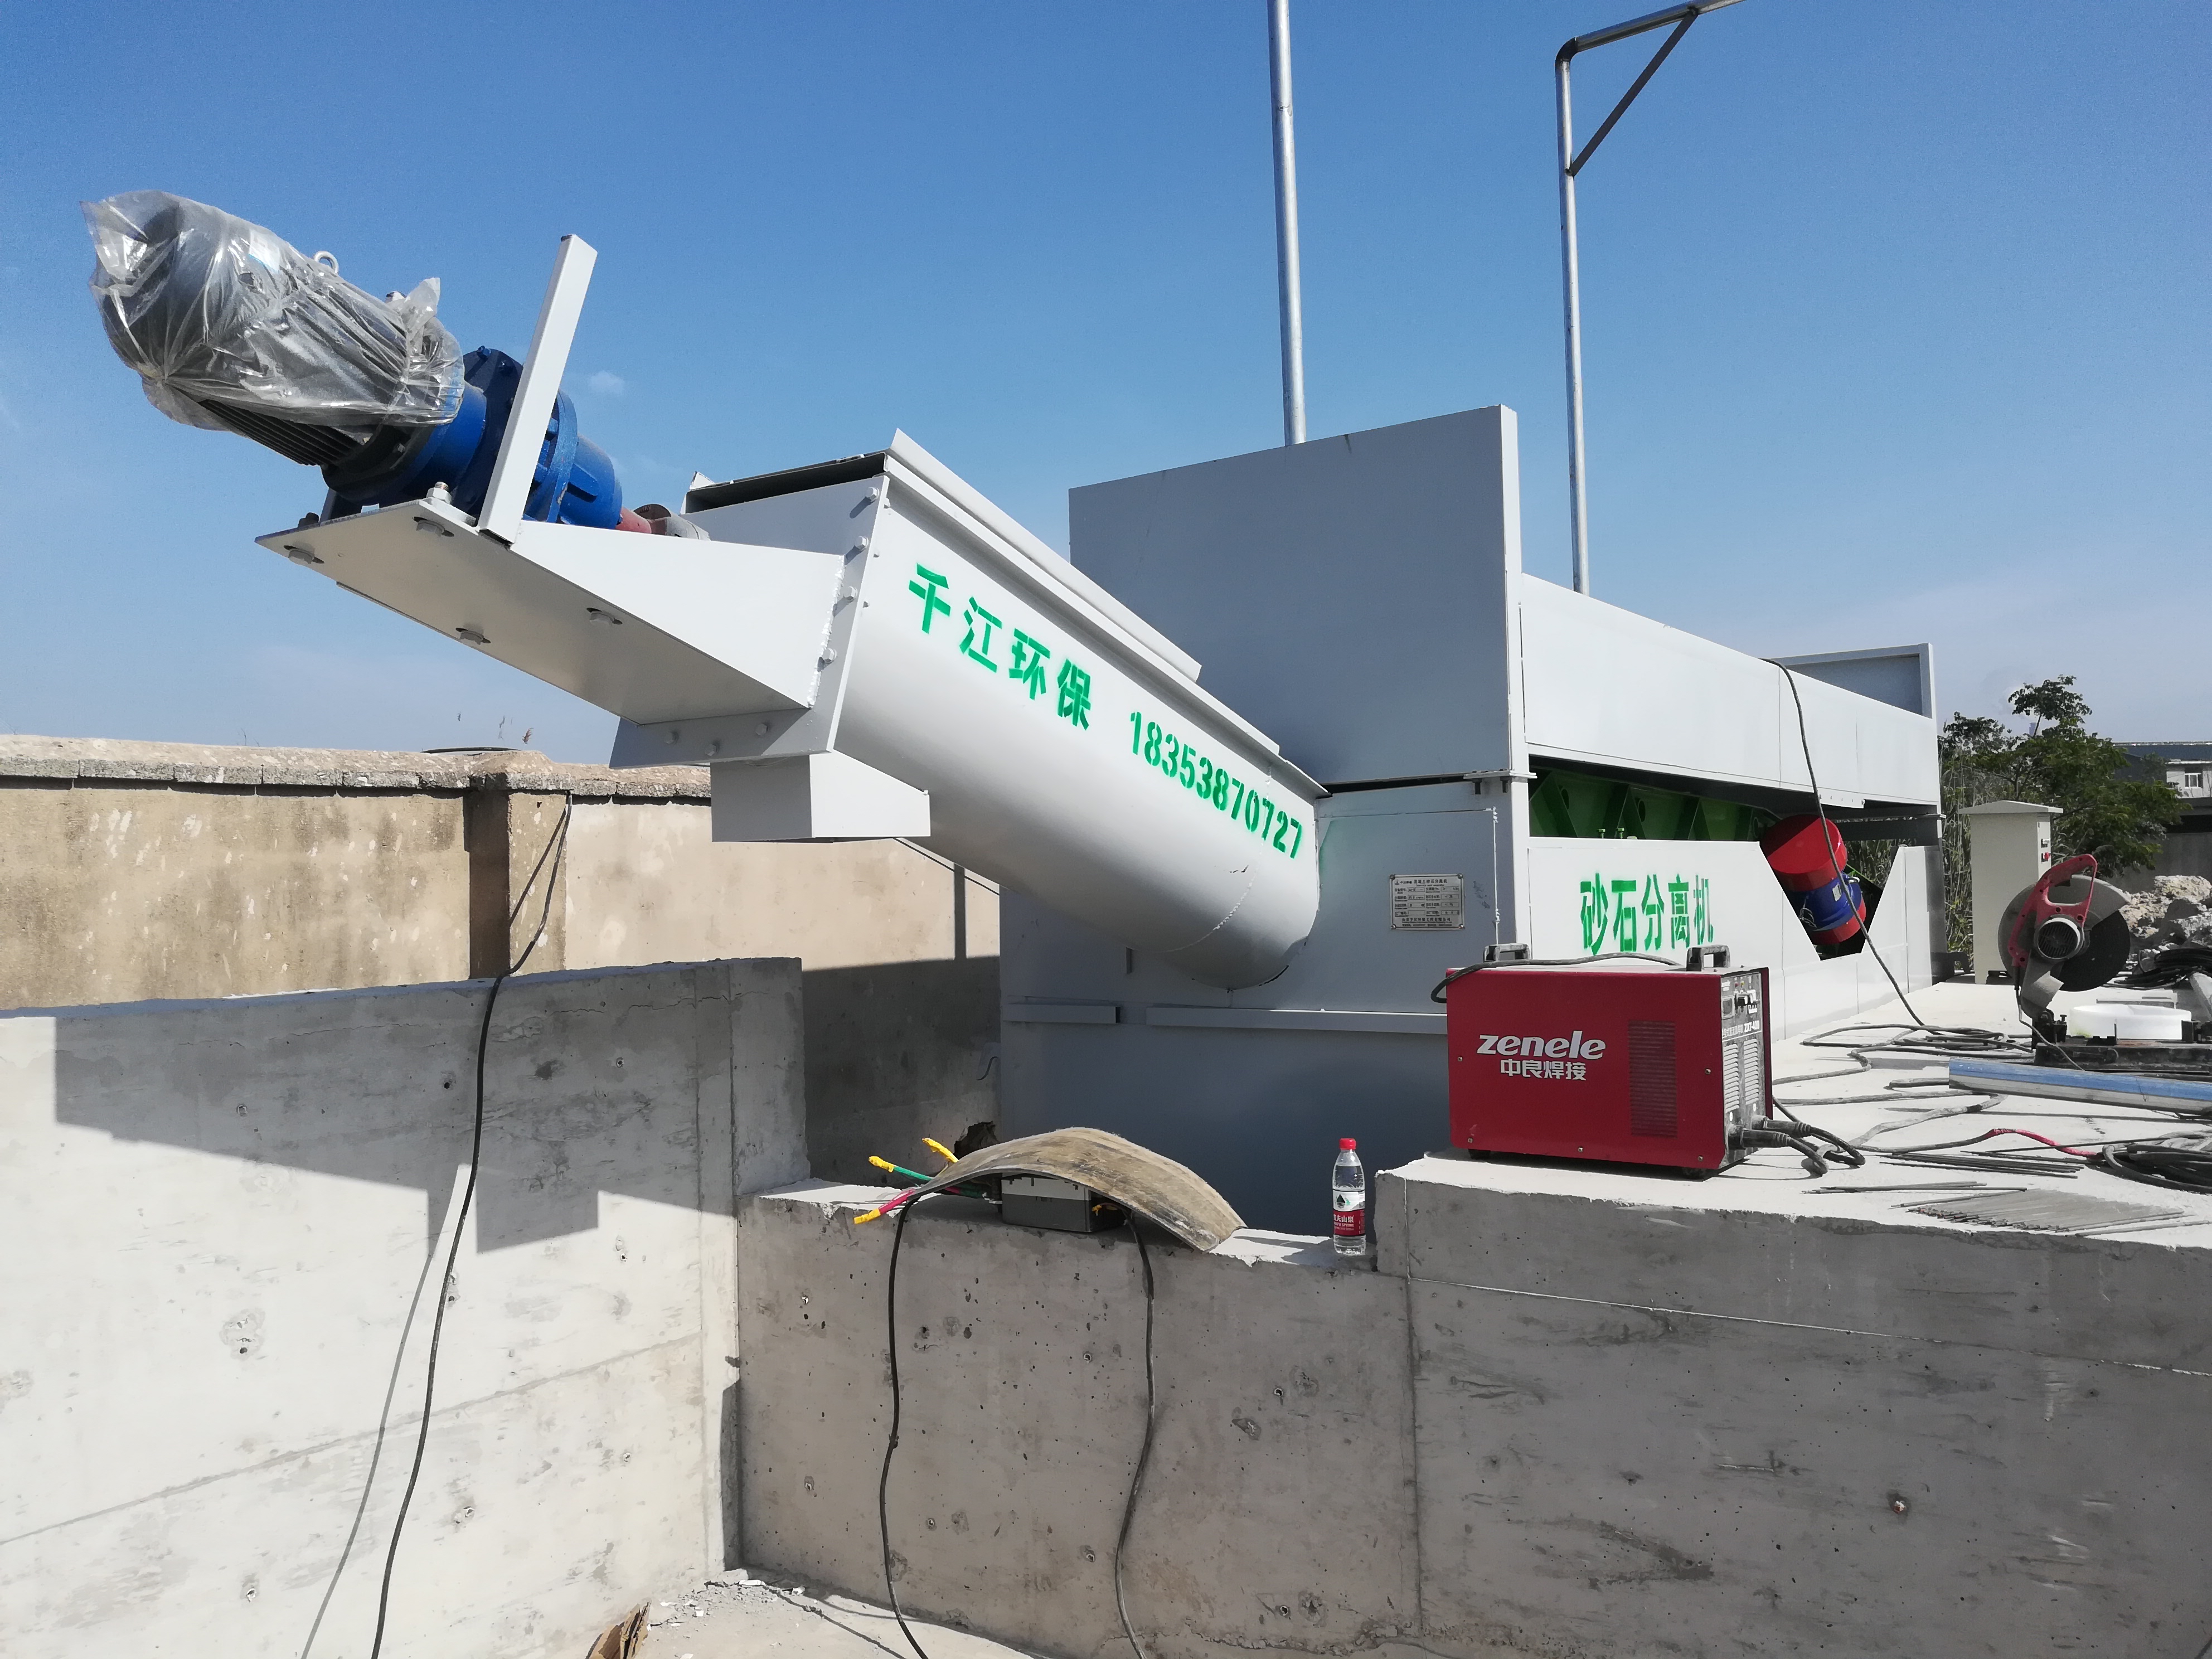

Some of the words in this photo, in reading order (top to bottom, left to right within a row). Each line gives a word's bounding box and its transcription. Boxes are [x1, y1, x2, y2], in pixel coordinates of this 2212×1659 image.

[909, 563, 1091, 731] 千江环保
[1131, 711, 1303, 859] 18353870727
[1580, 872, 1714, 956] 砂石分离机
[1477, 1030, 1607, 1060] zenele
[1500, 1059, 1587, 1081] 中良焊接
